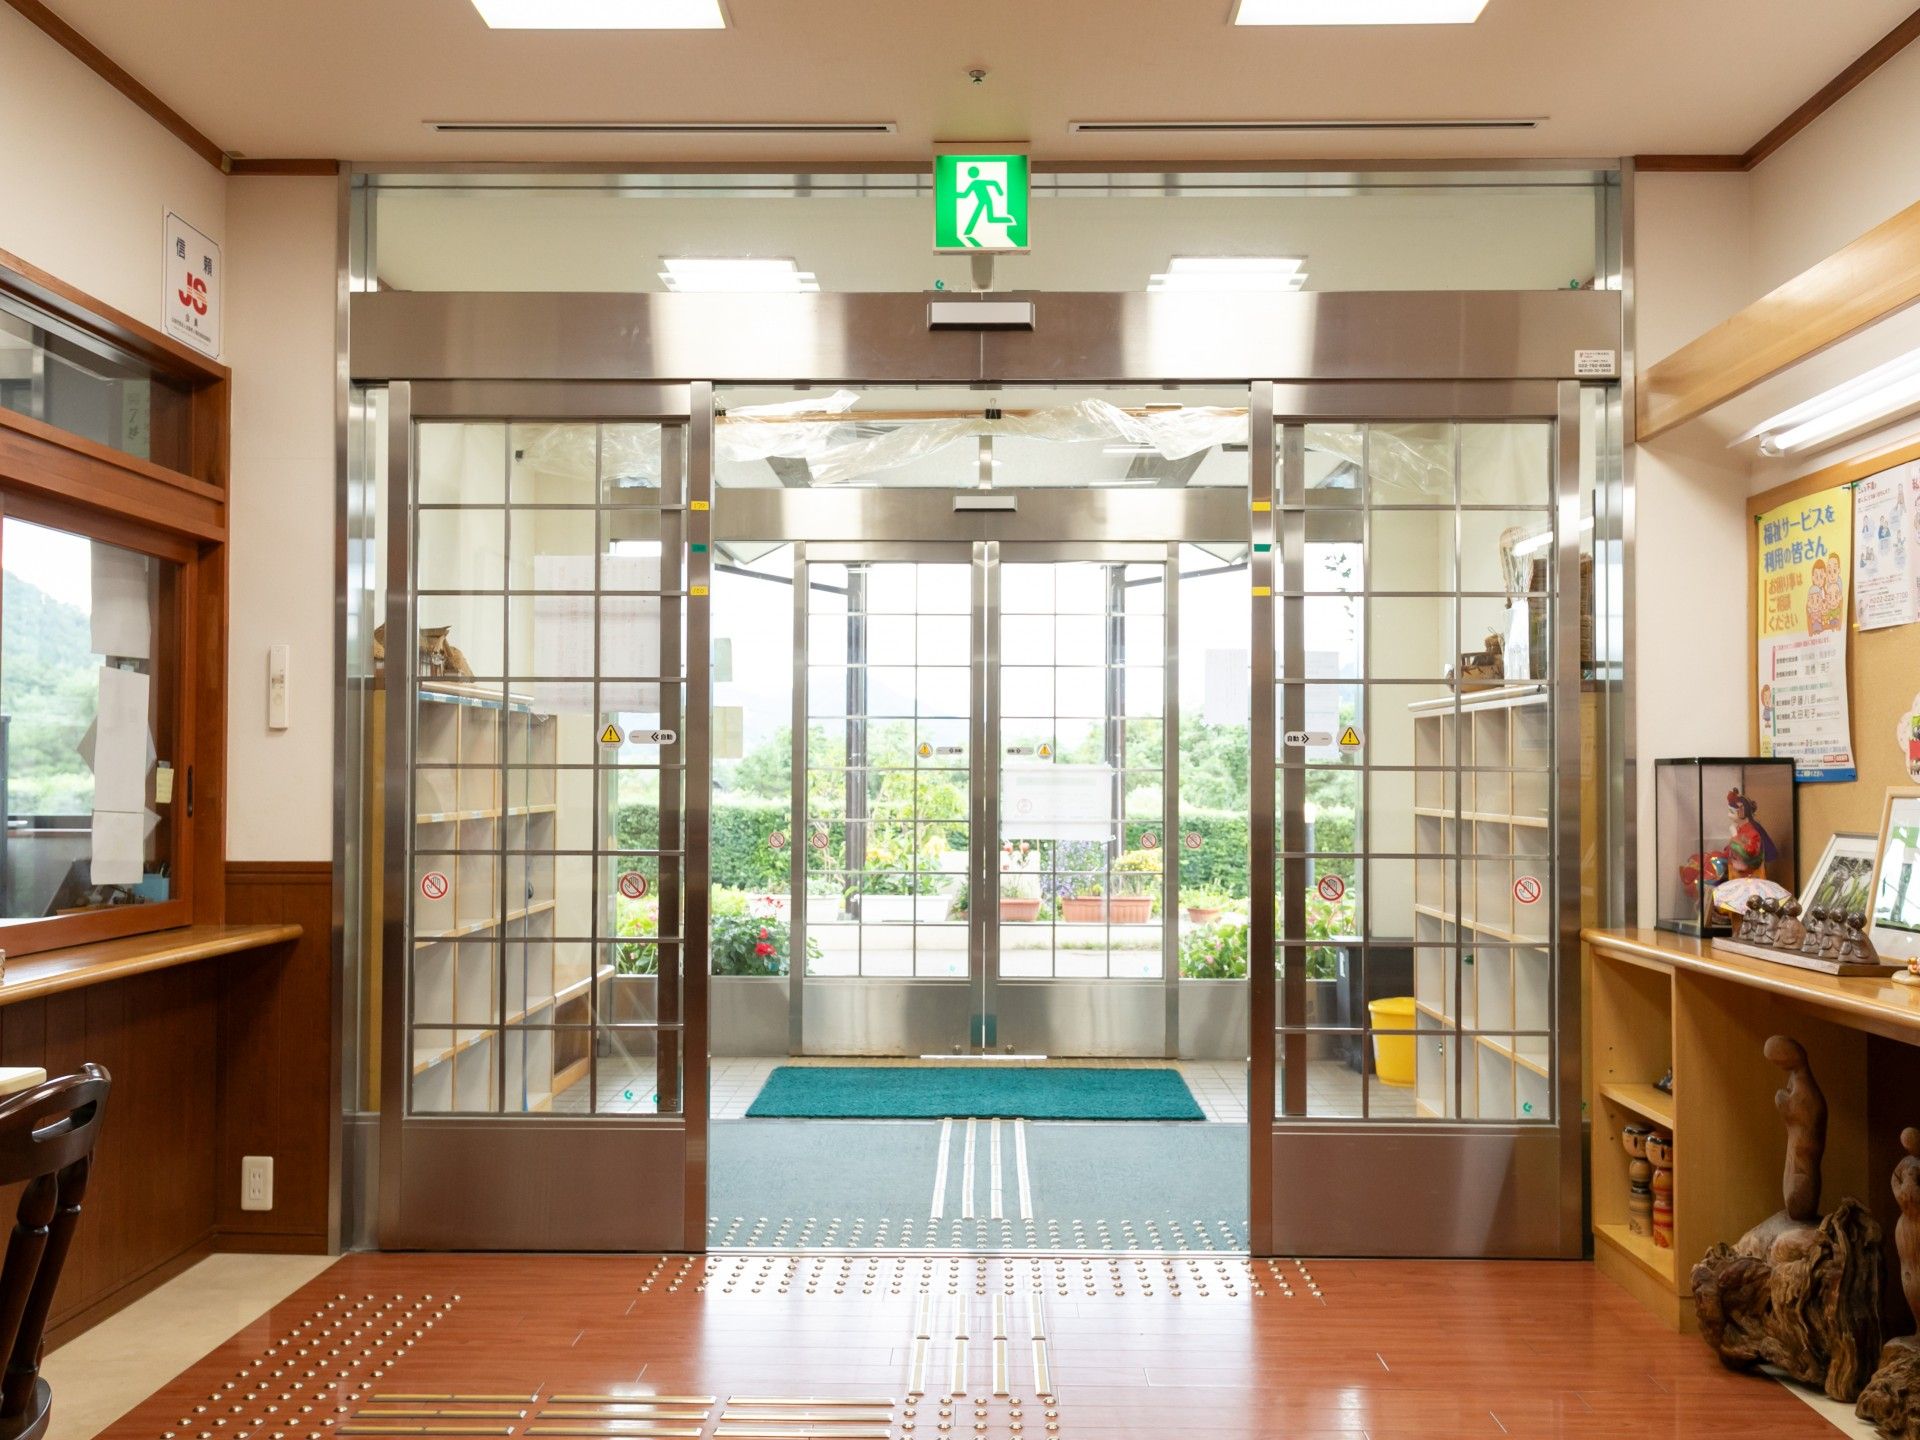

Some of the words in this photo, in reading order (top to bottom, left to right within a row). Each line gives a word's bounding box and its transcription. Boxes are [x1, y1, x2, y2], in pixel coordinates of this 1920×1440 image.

[1763, 505, 1835, 545] 福祉サービスを
[1765, 536, 1828, 573] 利用の皆さん
[1768, 613, 1799, 632] ください
